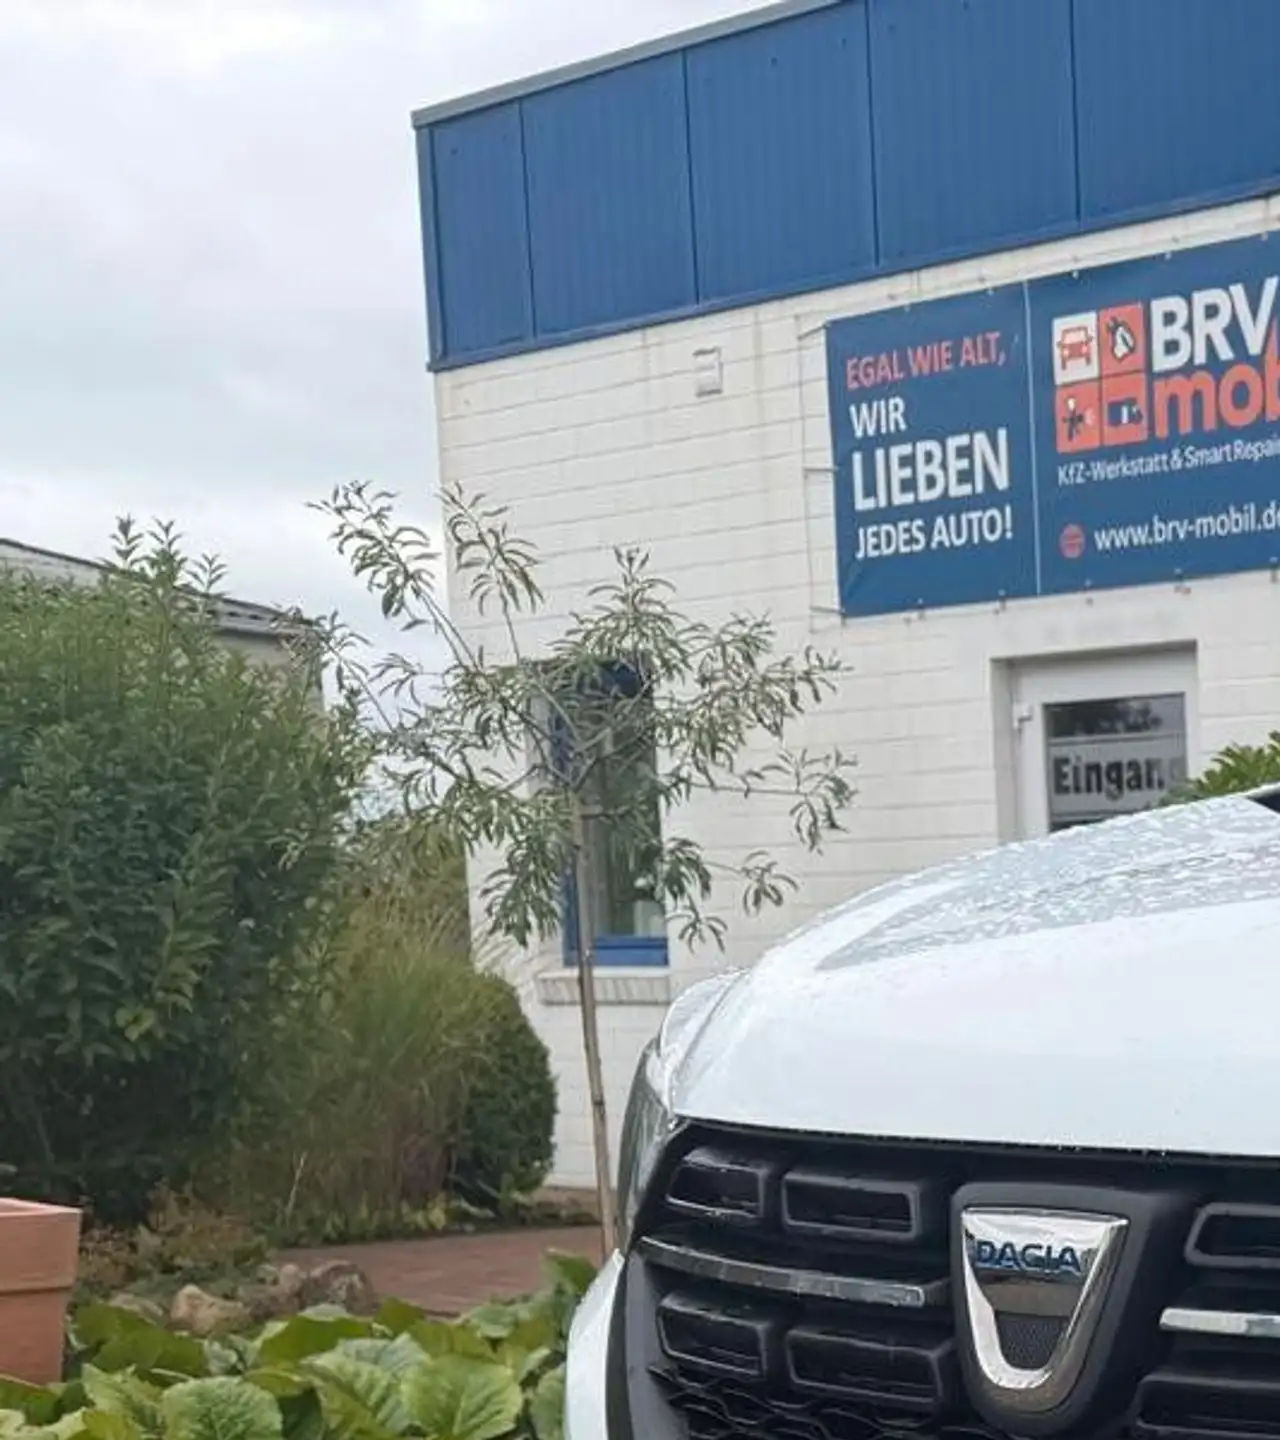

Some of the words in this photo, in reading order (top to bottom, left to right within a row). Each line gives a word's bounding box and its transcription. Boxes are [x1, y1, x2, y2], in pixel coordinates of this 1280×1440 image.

[1150, 276, 1280, 372] BRV
[846, 350, 904, 389] EGAL
[907, 340, 953, 377] WIE
[960, 331, 1006, 368] ALT,
[850, 396, 907, 439] WIR
[852, 427, 1010, 511] LIEBEN
[1170, 449, 1182, 470] &
[1185, 442, 1232, 468] Smart
[856, 519, 926, 561] JEDES
[931, 504, 1014, 550] AUTO!
[1053, 754, 1184, 801] Eingan
[976, 1240, 1081, 1273] DACIA
